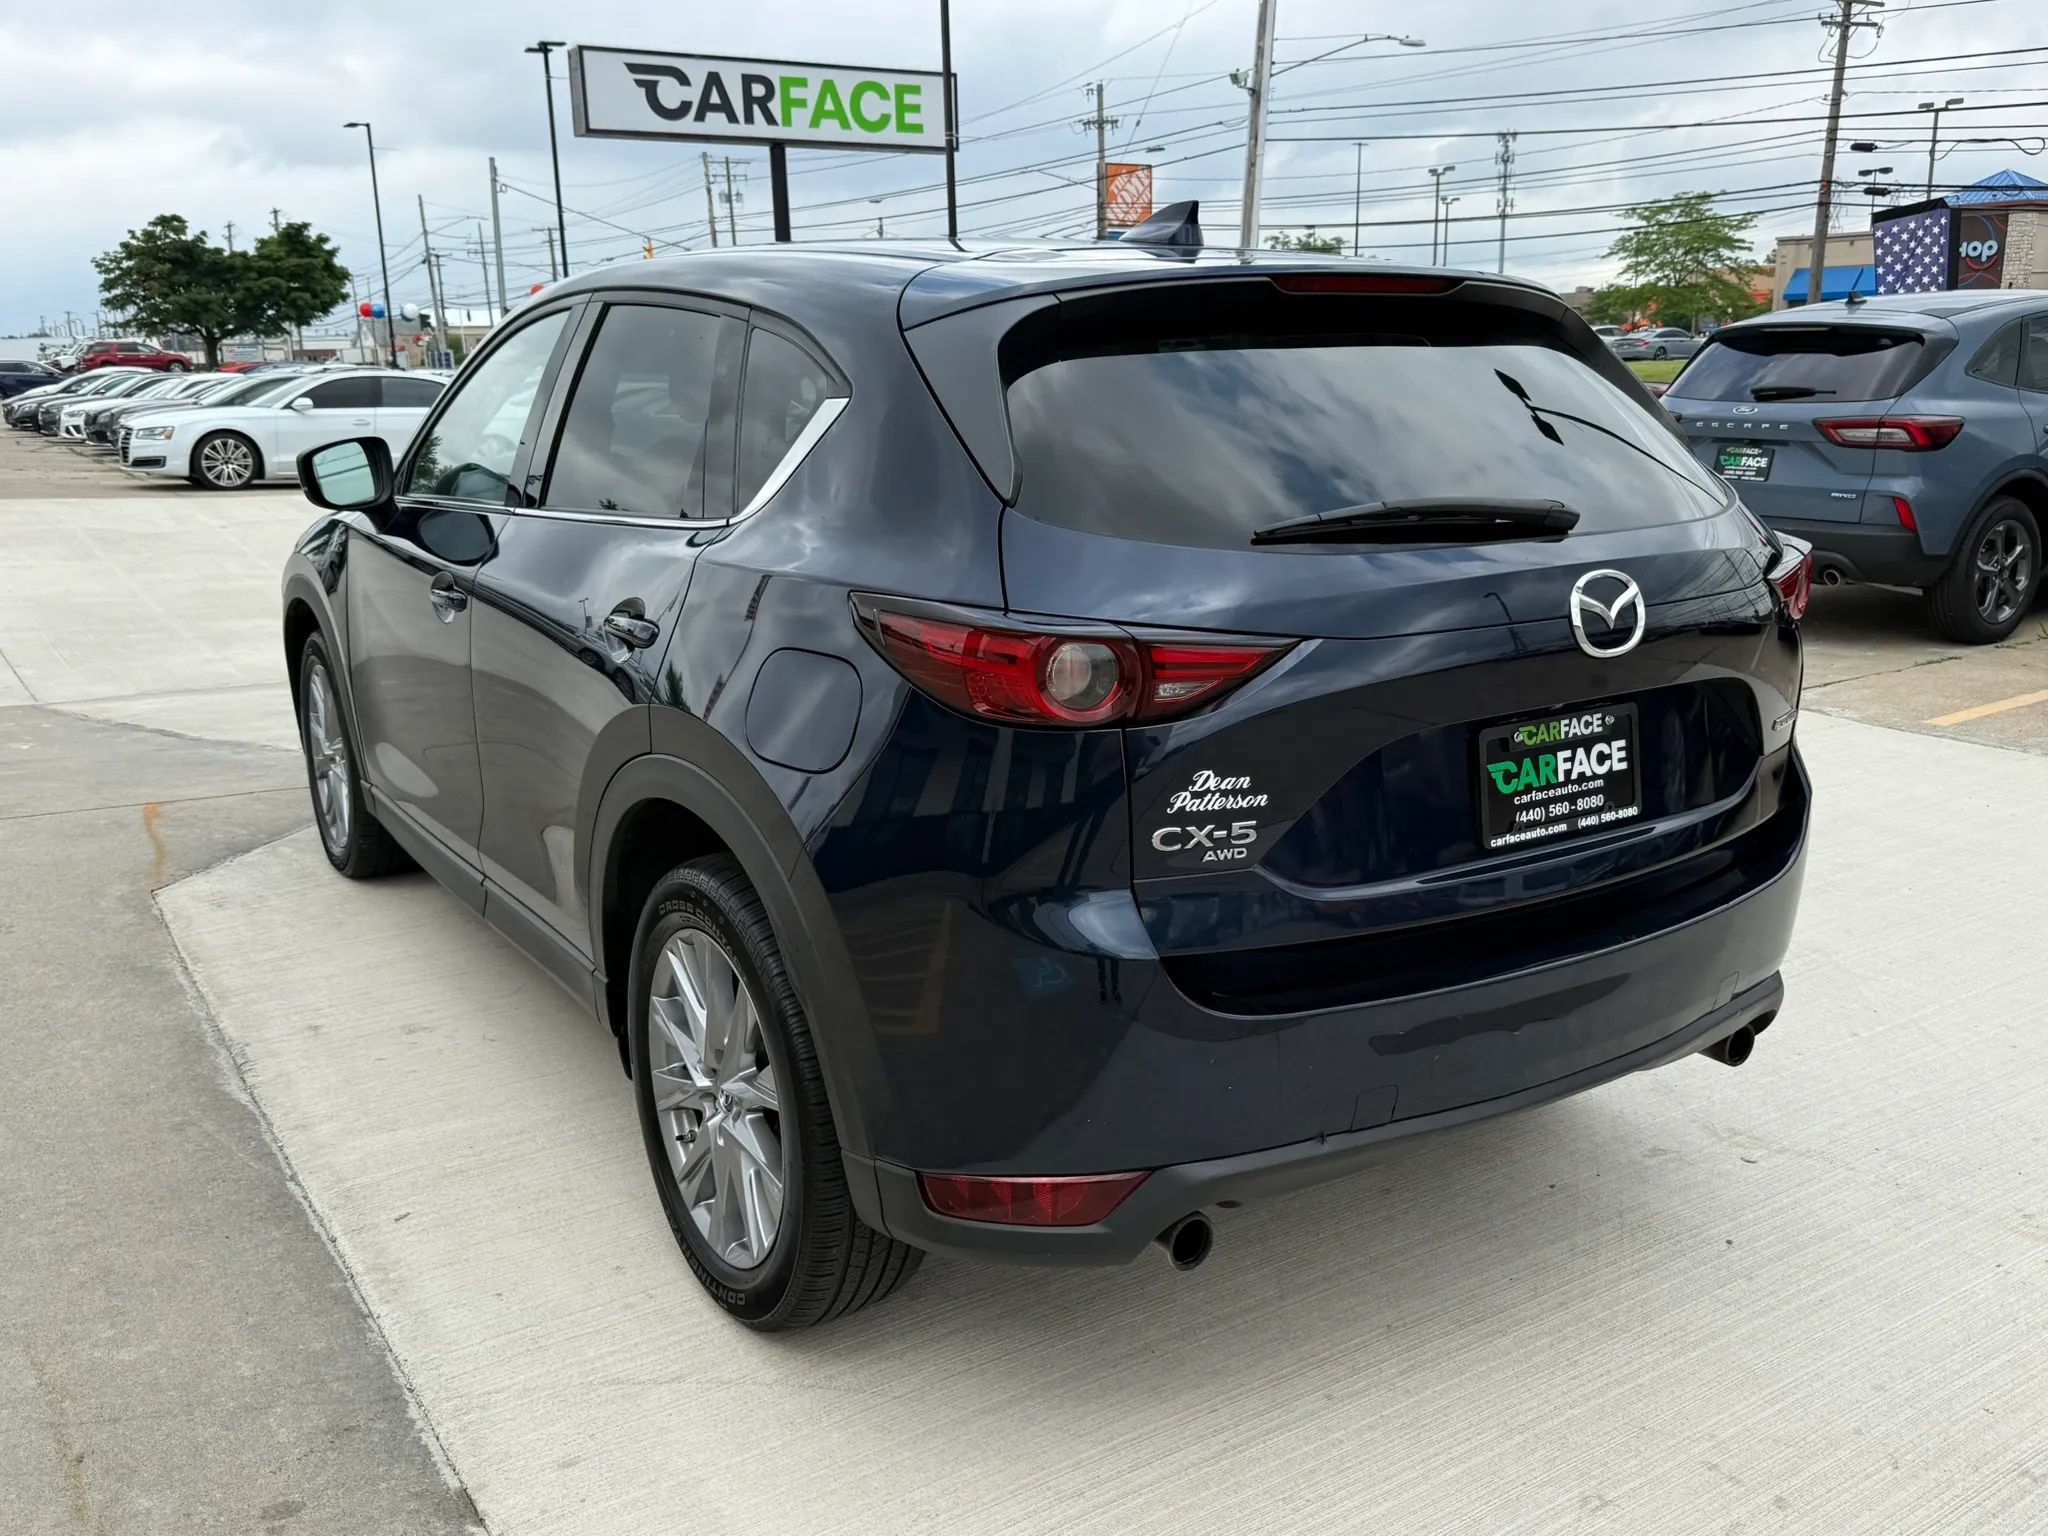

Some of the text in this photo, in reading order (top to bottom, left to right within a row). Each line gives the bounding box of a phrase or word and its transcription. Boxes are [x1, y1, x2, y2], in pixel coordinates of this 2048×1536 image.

[623, 62, 924, 134] CARFACE
[1696, 422, 1789, 430] ESCAPE
[1719, 455, 1768, 468] CARFACE
[1518, 713, 1603, 746] CARFACE
[1486, 739, 1628, 795] CARFACE
[1188, 770, 1251, 791] Dean
[1513, 778, 1604, 805] carfaceauto.com
[1167, 791, 1268, 814] Patterson
[1516, 807, 1545, 823] (440)
[1151, 821, 1257, 852] CX-5
[1490, 806, 1638, 847] carfaceauto.com (440) 560-8080
[1202, 848, 1247, 863] AWD
